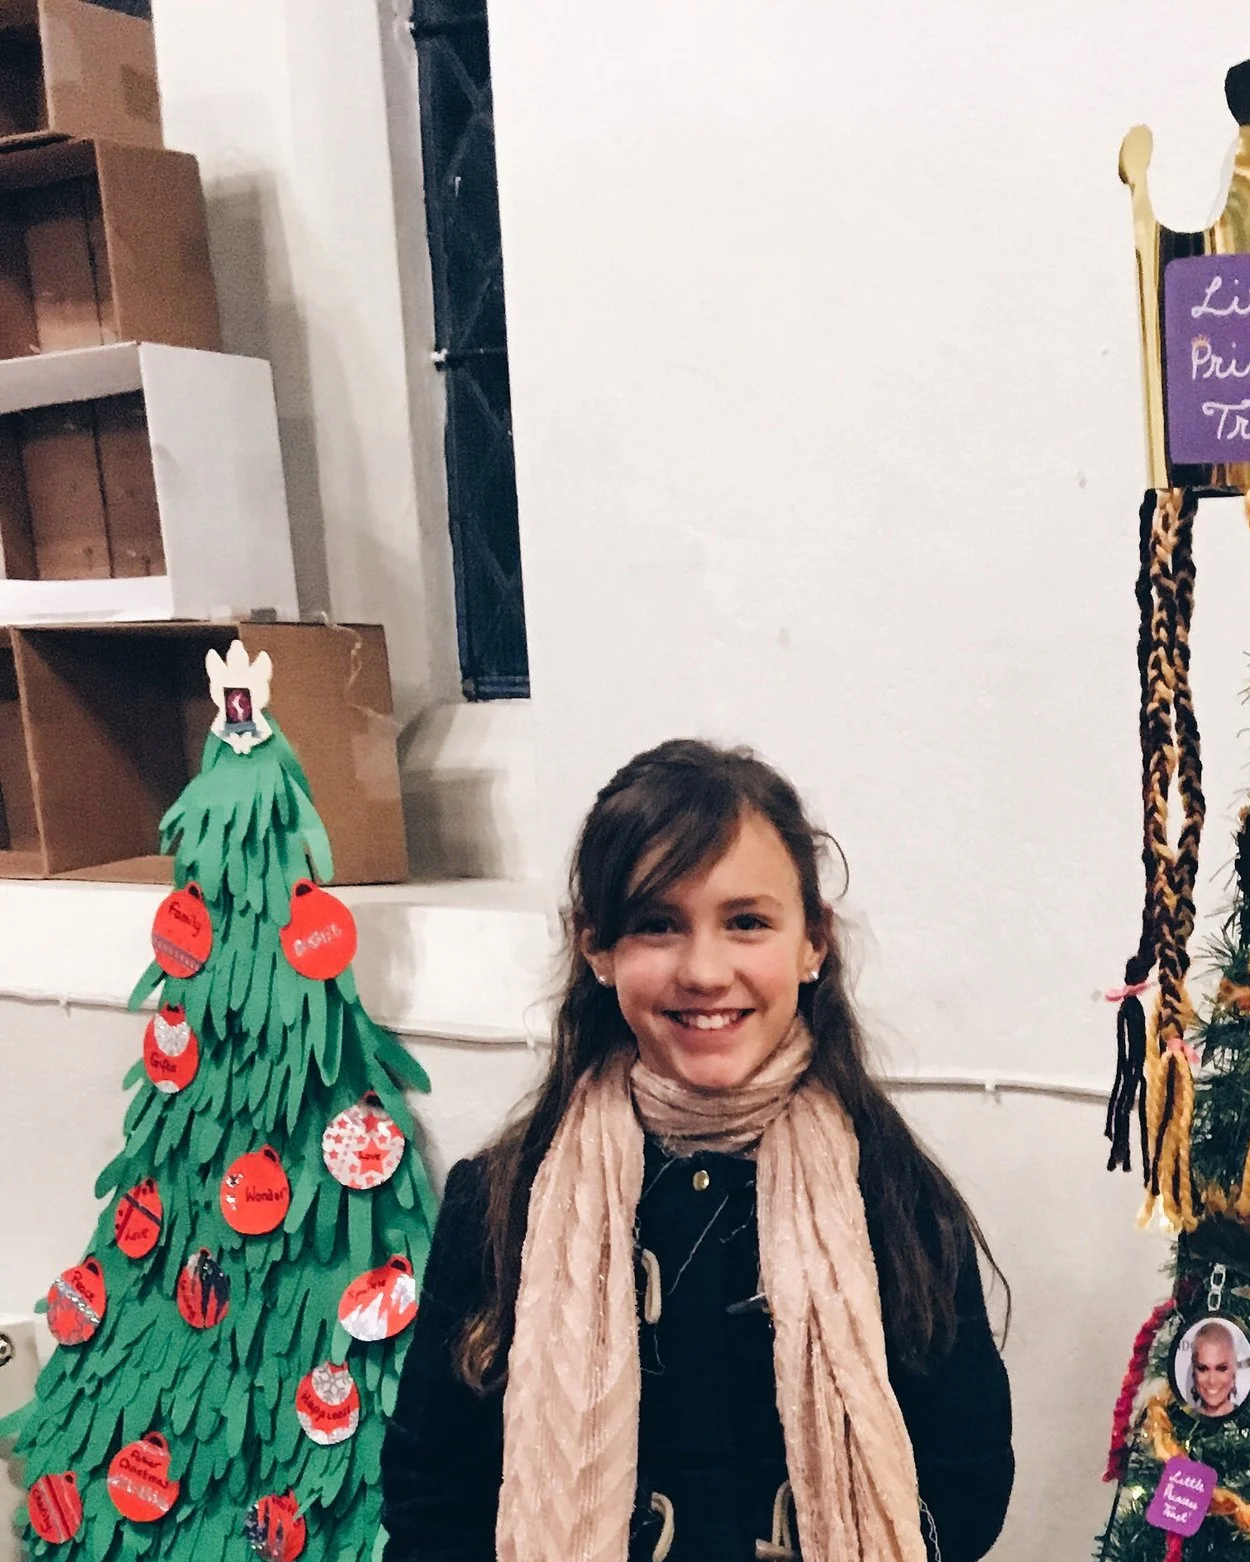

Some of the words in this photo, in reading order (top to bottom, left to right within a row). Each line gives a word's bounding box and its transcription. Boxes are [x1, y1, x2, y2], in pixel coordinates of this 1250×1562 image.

[168, 901, 201, 937] Family
[245, 1185, 288, 1202] Wonder
[1169, 1470, 1205, 1493] Little
